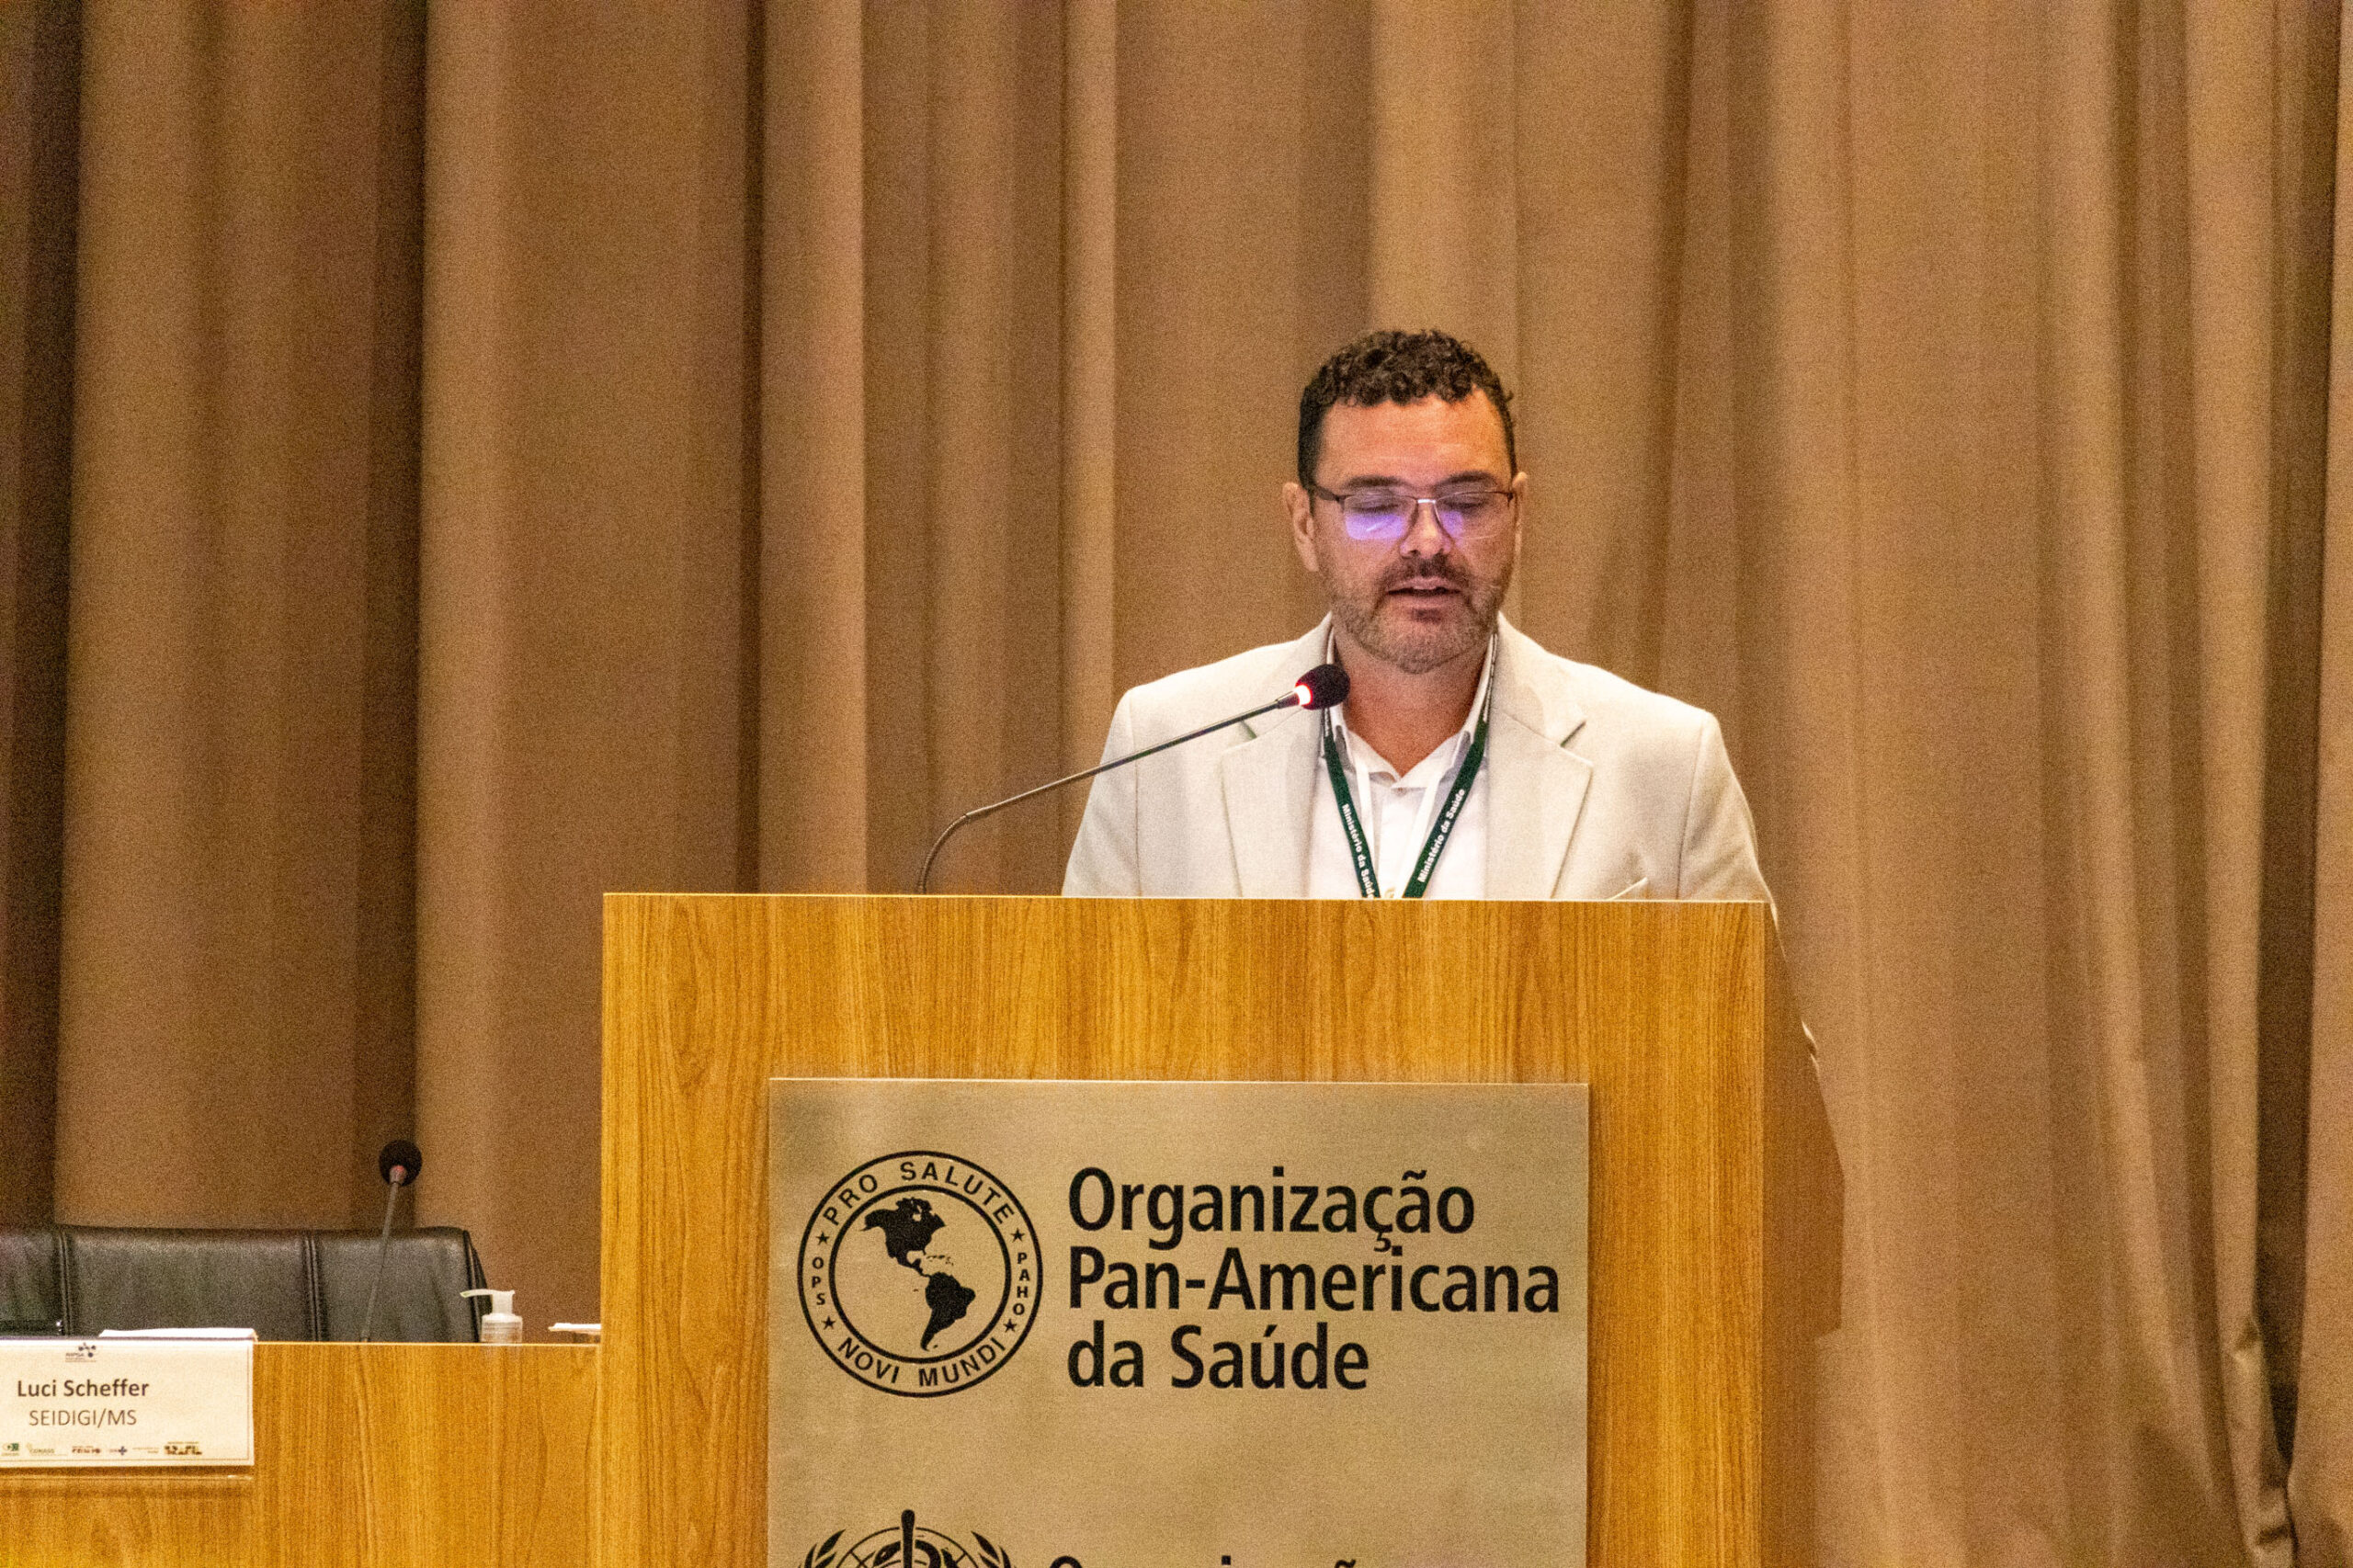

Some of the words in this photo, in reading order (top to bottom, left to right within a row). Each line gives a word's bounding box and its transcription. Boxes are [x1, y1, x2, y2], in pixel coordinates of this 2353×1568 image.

[1342, 803, 1362, 853] Ministério
[1358, 854, 1367, 869] da
[1417, 835, 1445, 883] Ministério
[1439, 819, 1451, 835] da
[1446, 789, 1465, 821] Saúde
[822, 1174, 879, 1226] PRO
[900, 1161, 1015, 1224] SALUTE
[1068, 1166, 1474, 1252] Organização
[811, 1256, 825, 1305] OPS
[1013, 1252, 1030, 1315] PAHO
[1069, 1245, 1559, 1312] Pan-Americana
[837, 1336, 900, 1384] NOVI
[918, 1336, 1006, 1387] MUNDI
[1067, 1320, 1144, 1388] da
[1171, 1322, 1370, 1390] Saúde
[17, 1379, 57, 1397] Luci
[63, 1379, 150, 1397] Scheffer
[28, 1408, 138, 1428] SEIDIGI/MS
